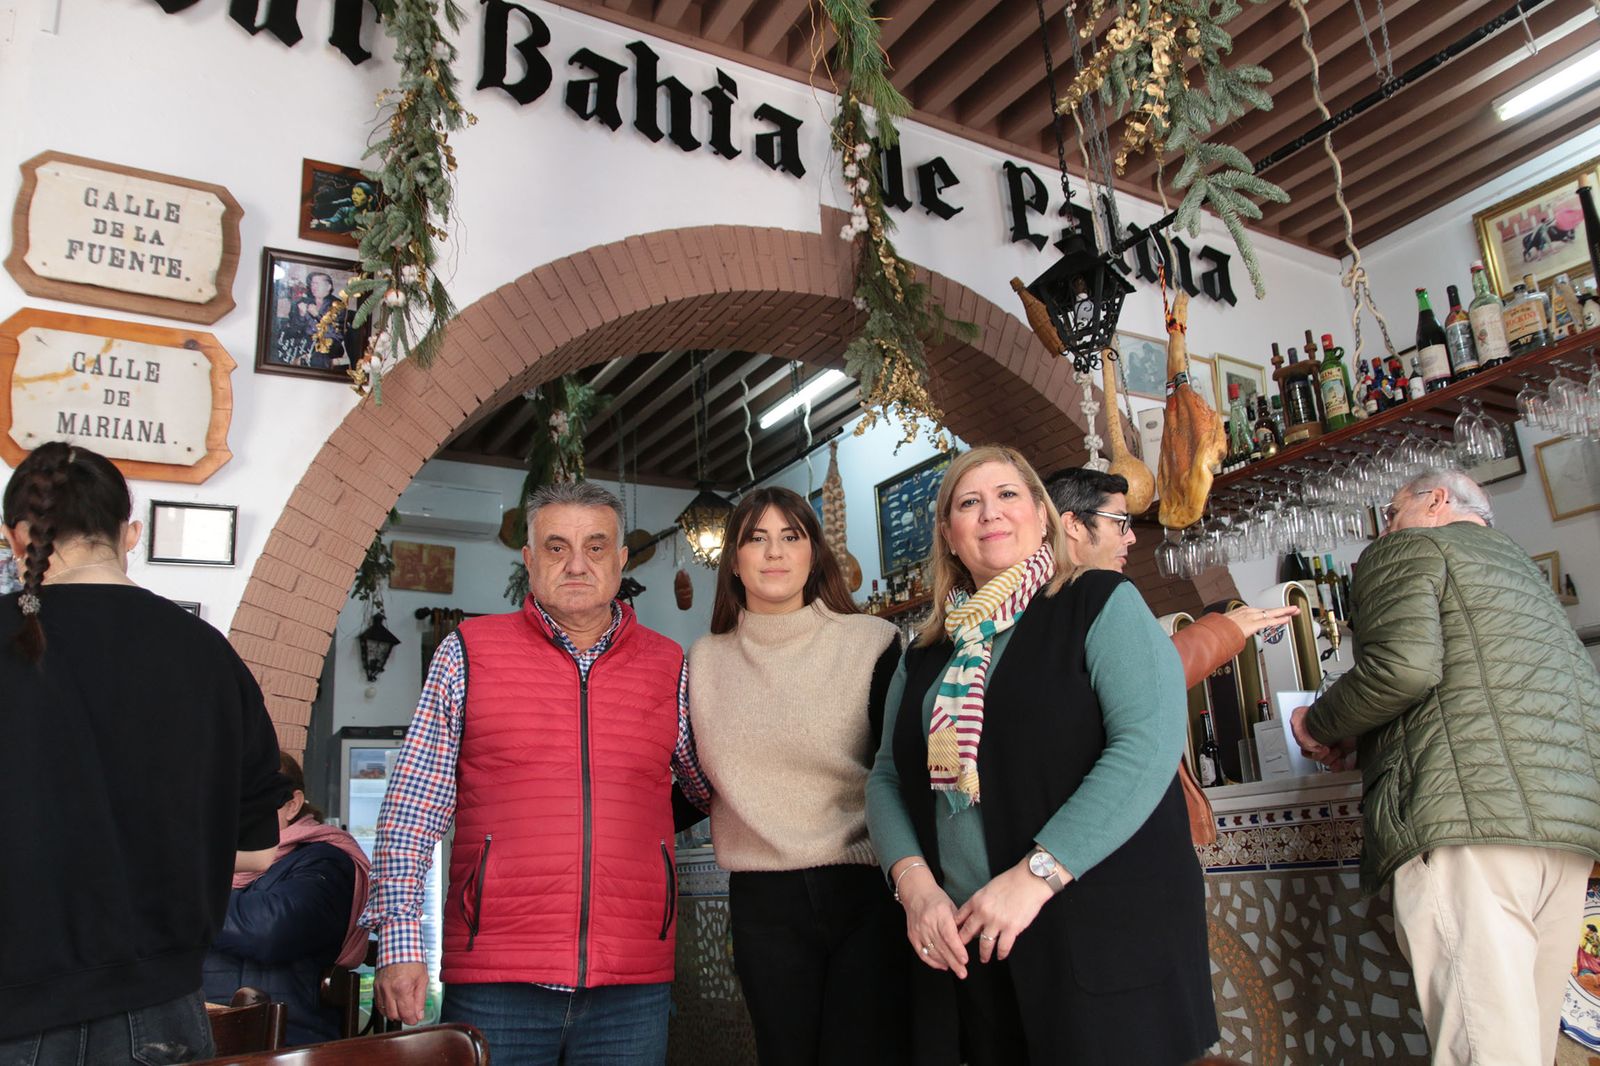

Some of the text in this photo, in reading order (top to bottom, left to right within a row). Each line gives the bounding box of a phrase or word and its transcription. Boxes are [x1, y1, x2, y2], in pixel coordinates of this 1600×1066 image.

[83, 187, 181, 224] CALLE
[92, 218, 165, 246] DE LA
[65, 239, 191, 281] FUENTE.
[72, 351, 160, 383] CALLE
[103, 388, 130, 407] DE
